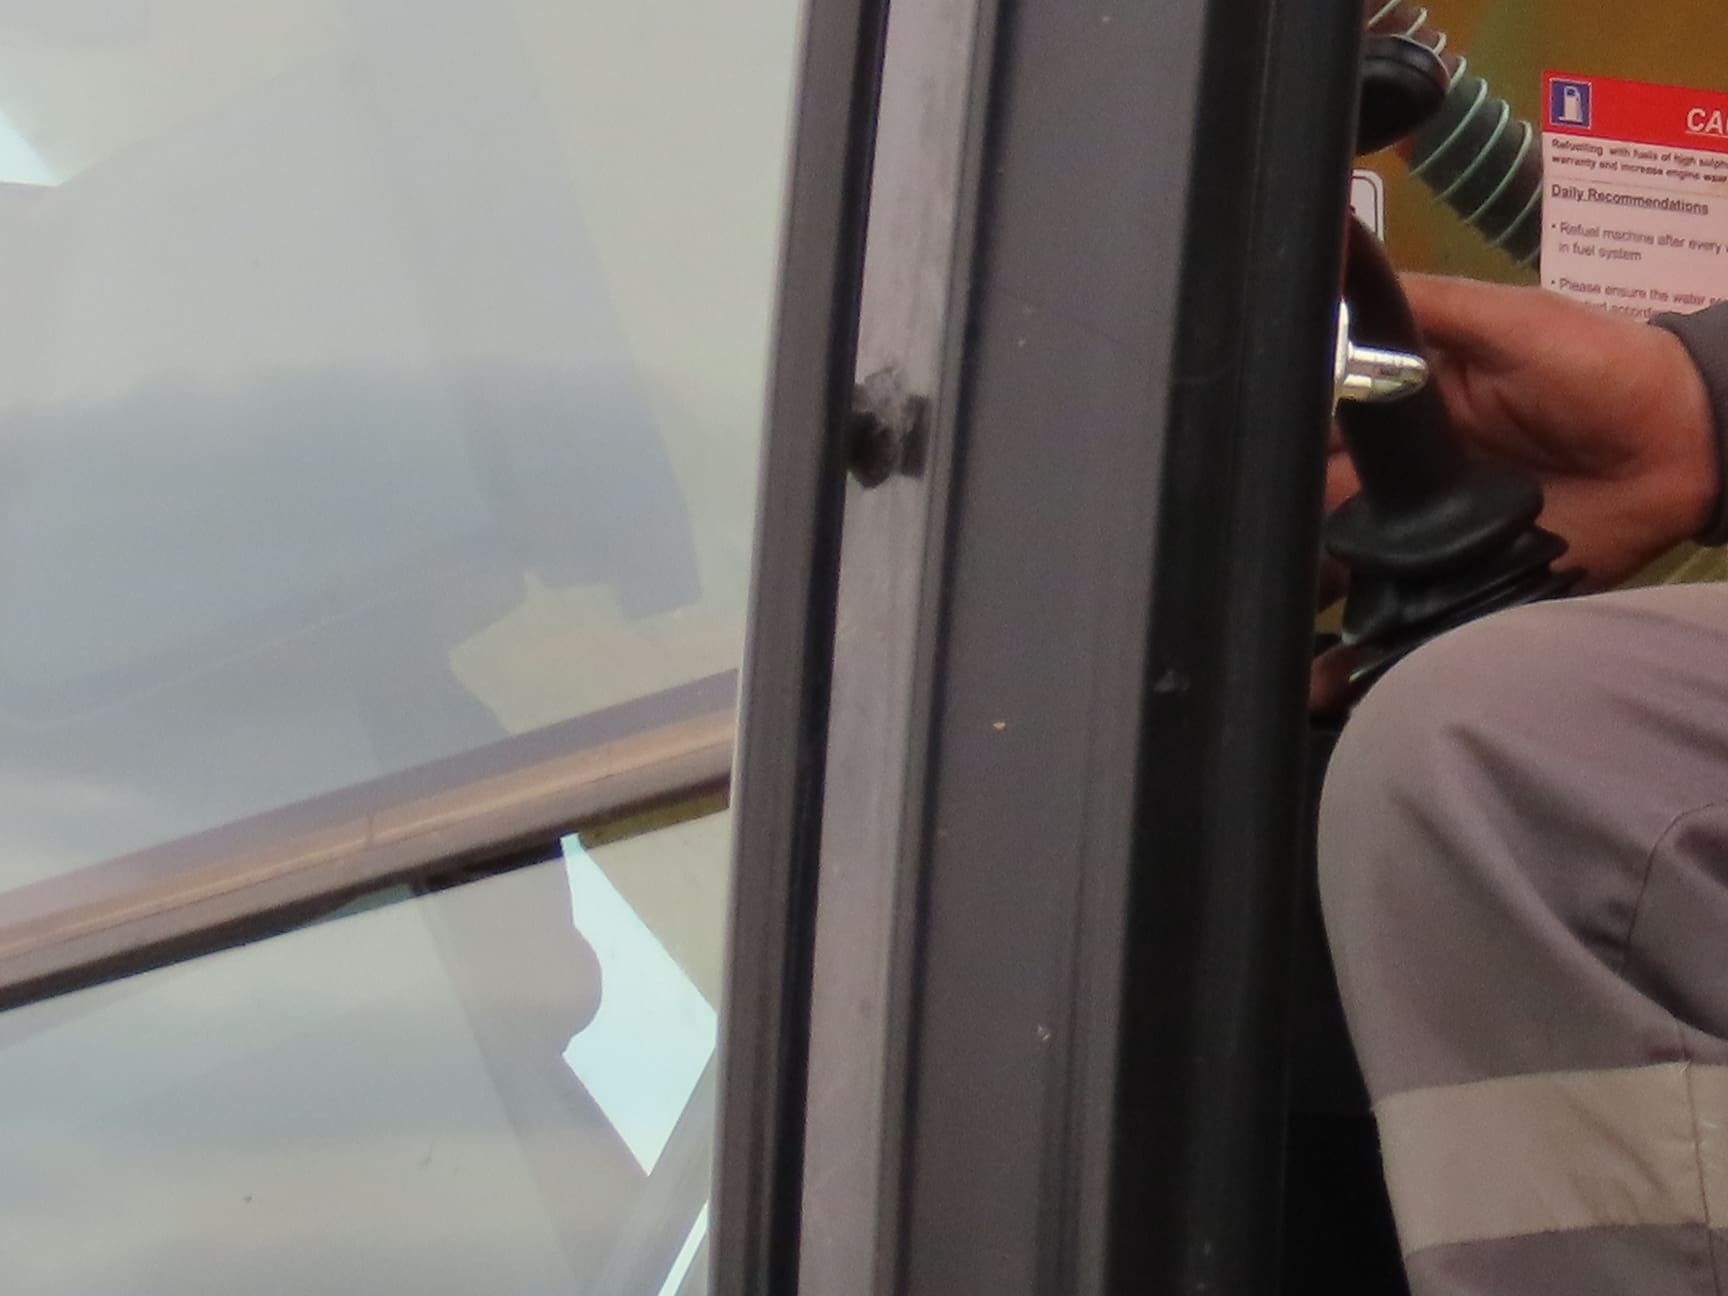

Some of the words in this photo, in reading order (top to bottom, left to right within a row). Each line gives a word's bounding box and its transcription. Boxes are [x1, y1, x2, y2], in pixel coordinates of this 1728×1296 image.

[1609, 145, 1631, 158] with
[1661, 152, 1672, 163] of
[1551, 156, 1597, 170] warranty
[1599, 160, 1618, 171] and
[1620, 163, 1664, 176] increase
[1665, 168, 1701, 181] engine
[1551, 183, 1588, 202] Daily
[1587, 187, 1709, 216] Recommendations
[1559, 241, 1569, 253] in
[1572, 243, 1596, 257] fuel
[1599, 247, 1643, 261] system
[1560, 221, 1600, 238] Refuel
[1602, 228, 1655, 246] machine
[1657, 233, 1686, 248] after
[1688, 239, 1722, 255] every
[1560, 277, 1602, 294] Please
[1604, 284, 1647, 299] ensure
[1649, 288, 1669, 301] the
[1673, 293, 1706, 305] water
